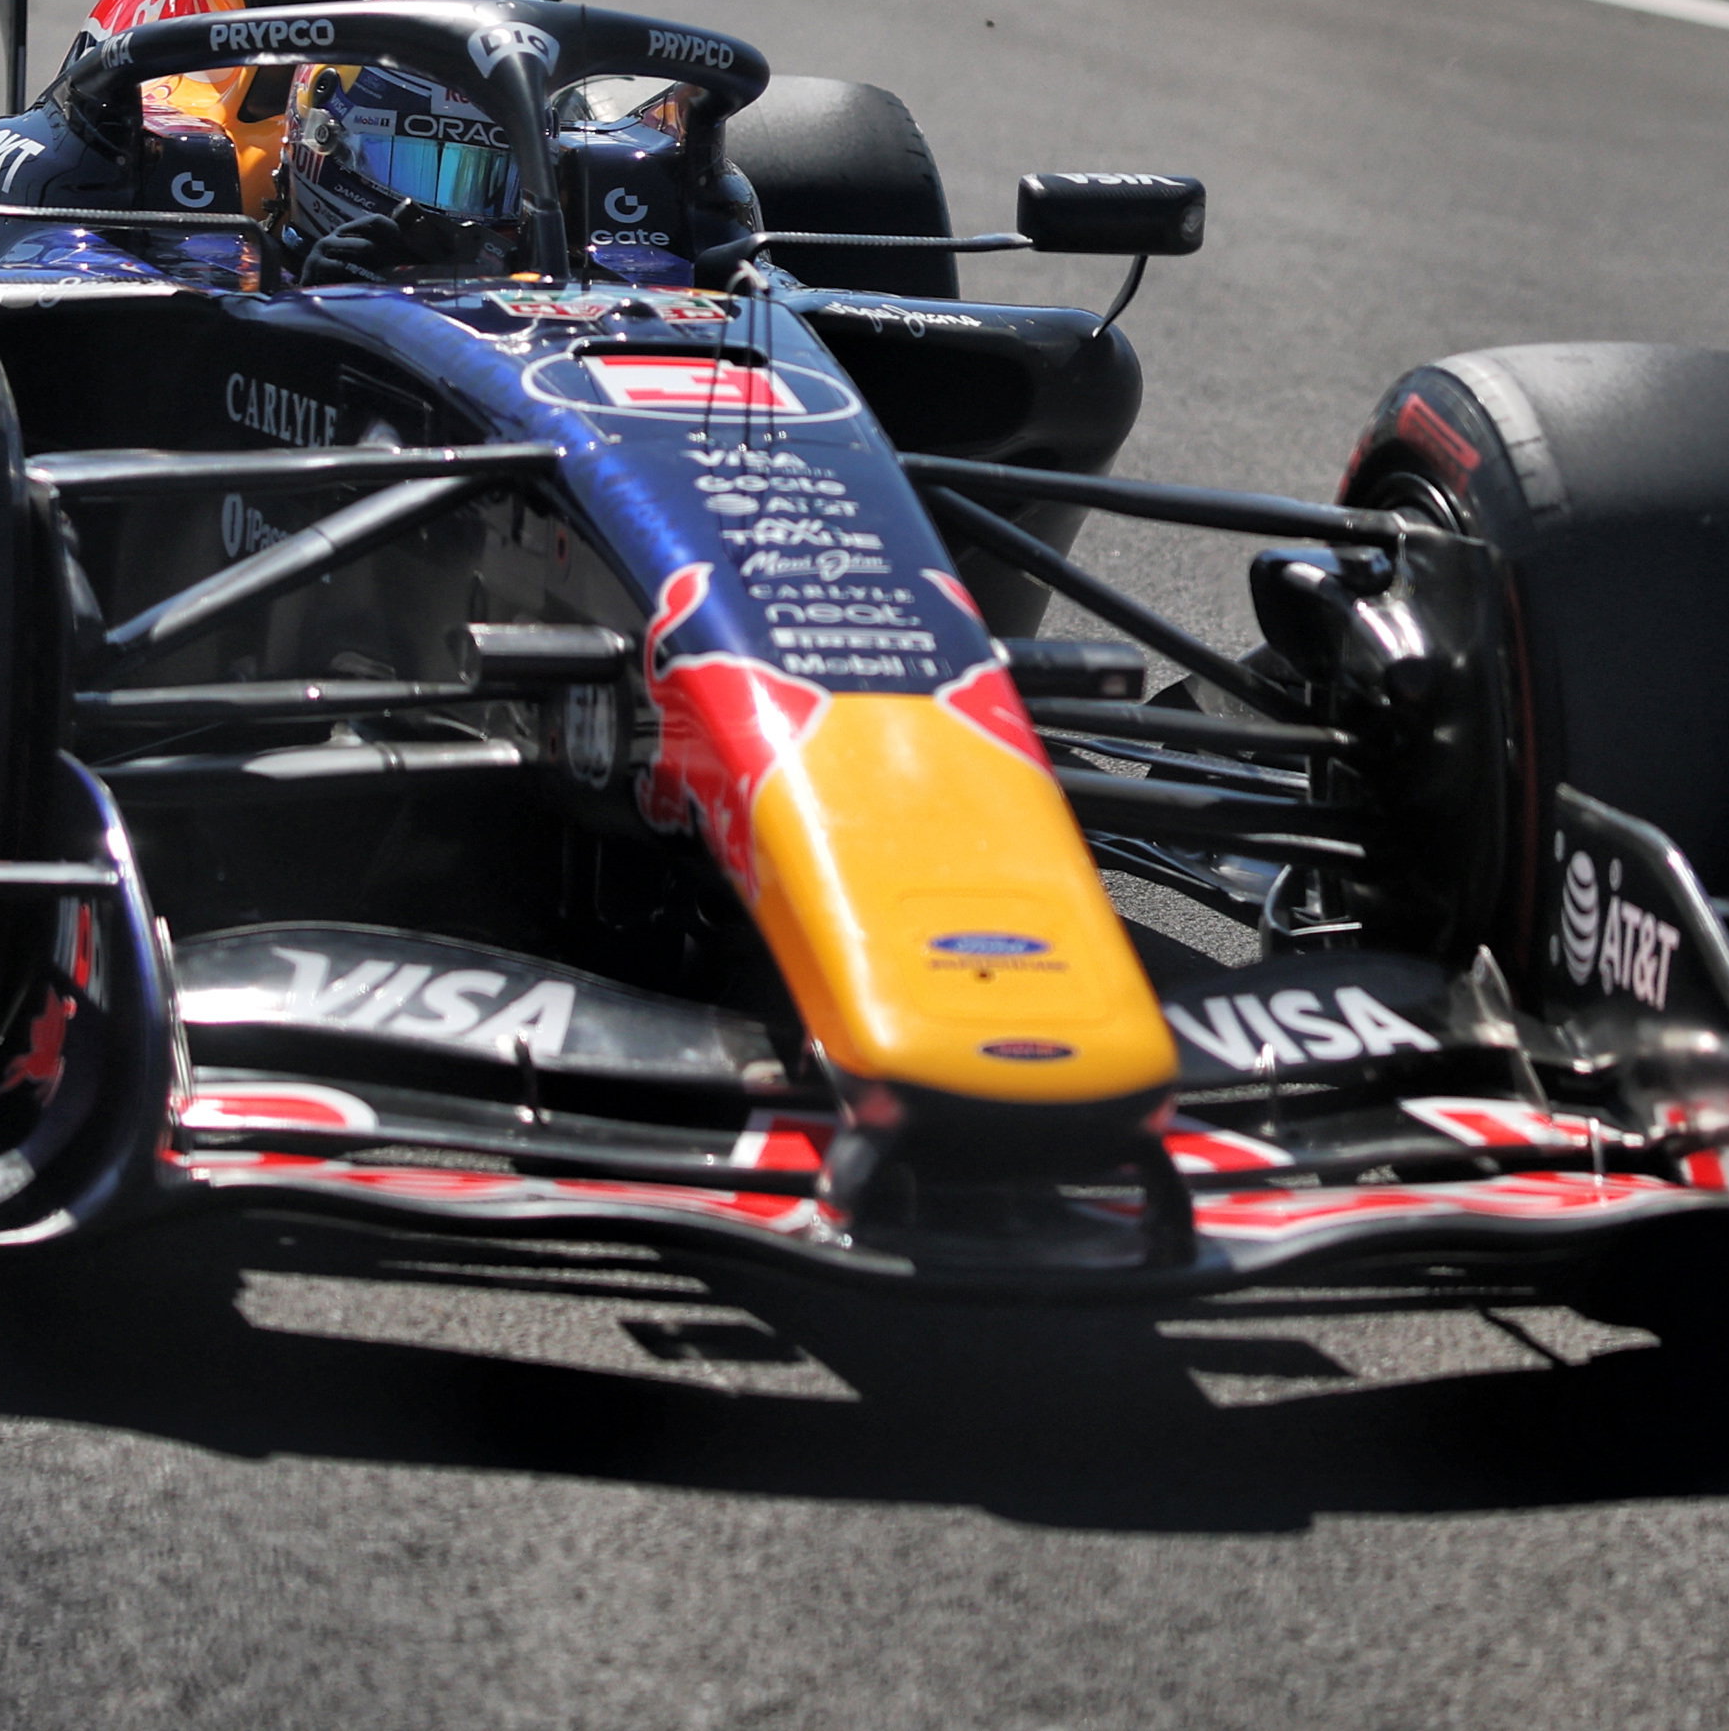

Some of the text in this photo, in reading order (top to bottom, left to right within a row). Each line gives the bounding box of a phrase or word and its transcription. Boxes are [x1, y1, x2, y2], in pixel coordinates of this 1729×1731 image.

[209, 18, 335, 52] PRYPCO
[647, 29, 734, 69] PRYPCO
[354, 115, 379, 128] Mobil
[404, 115, 510, 149] ORAC
[334, 184, 376, 211] DAMAC
[590, 229, 670, 246] Gate
[749, 584, 916, 604] CARLYLE
[772, 626, 936, 652] PIRELLI
[782, 653, 907, 677] Mobil
[1600, 897, 1679, 1011] AT&T
[273, 946, 575, 1059] VISA
[1165, 986, 1441, 1073] VISA
